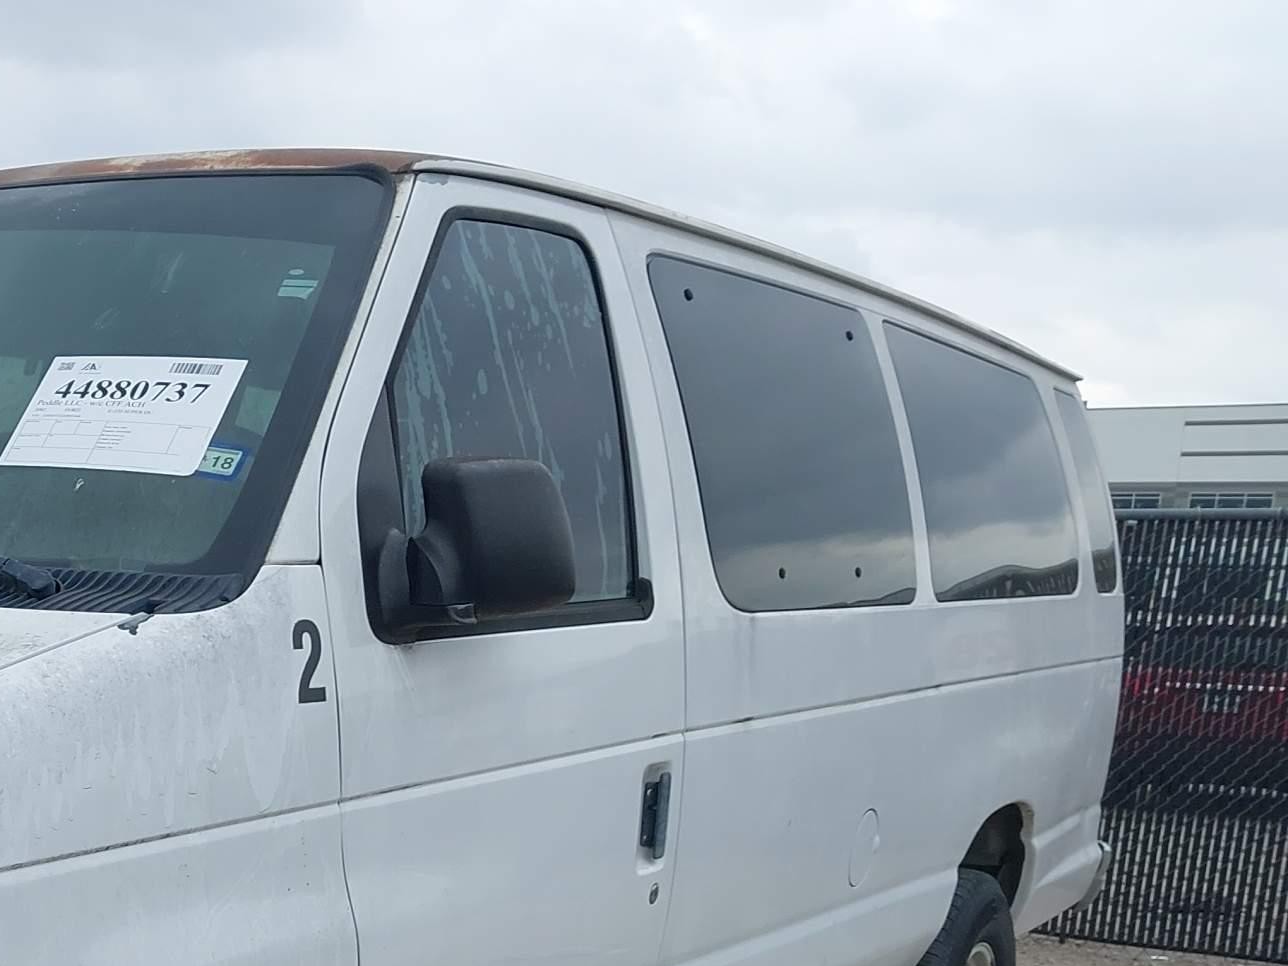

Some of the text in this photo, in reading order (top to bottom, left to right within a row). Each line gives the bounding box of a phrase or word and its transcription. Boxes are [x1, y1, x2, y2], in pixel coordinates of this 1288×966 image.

[54, 379, 210, 404] 44880737
[212, 455, 234, 469] 18
[292, 618, 327, 704] 2
